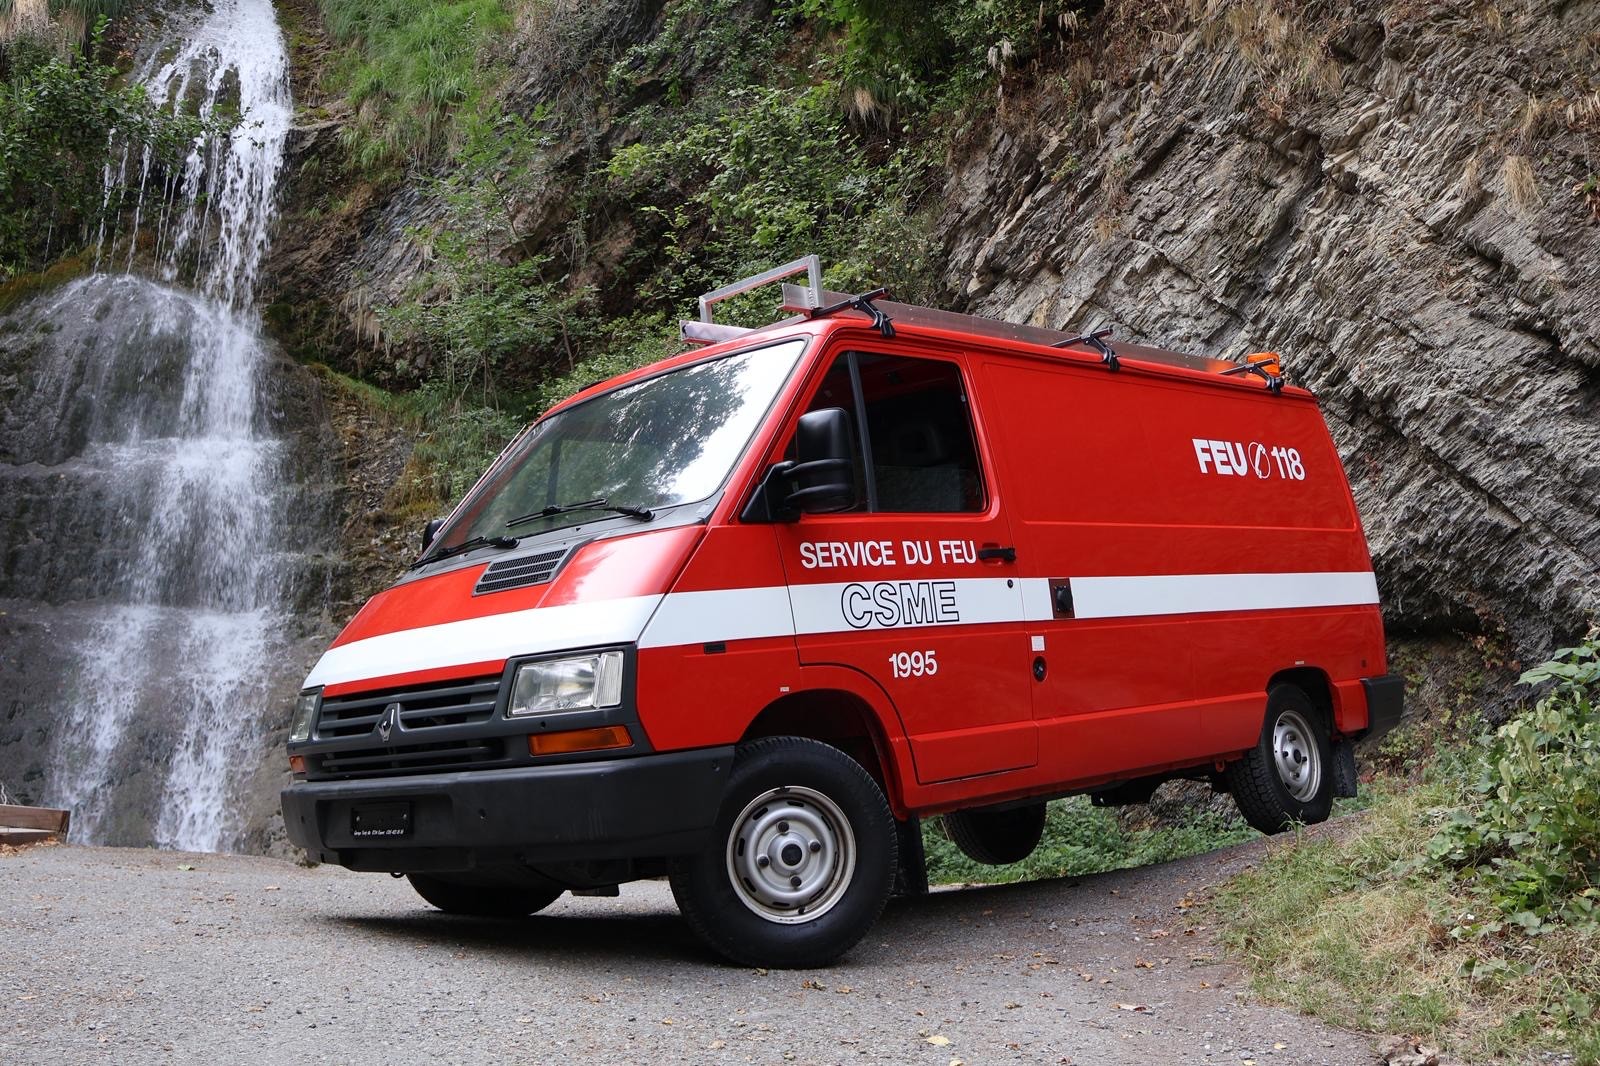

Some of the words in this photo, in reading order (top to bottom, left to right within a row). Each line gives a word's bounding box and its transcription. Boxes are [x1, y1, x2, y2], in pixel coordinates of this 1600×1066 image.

[1192, 438, 1248, 476] FEU
[1271, 446, 1305, 480] 118
[800, 540, 896, 569] SERVICE
[902, 540, 933, 565] DU
[938, 540, 977, 564] FEU
[841, 581, 960, 629] CSME
[888, 650, 938, 678] 1995
